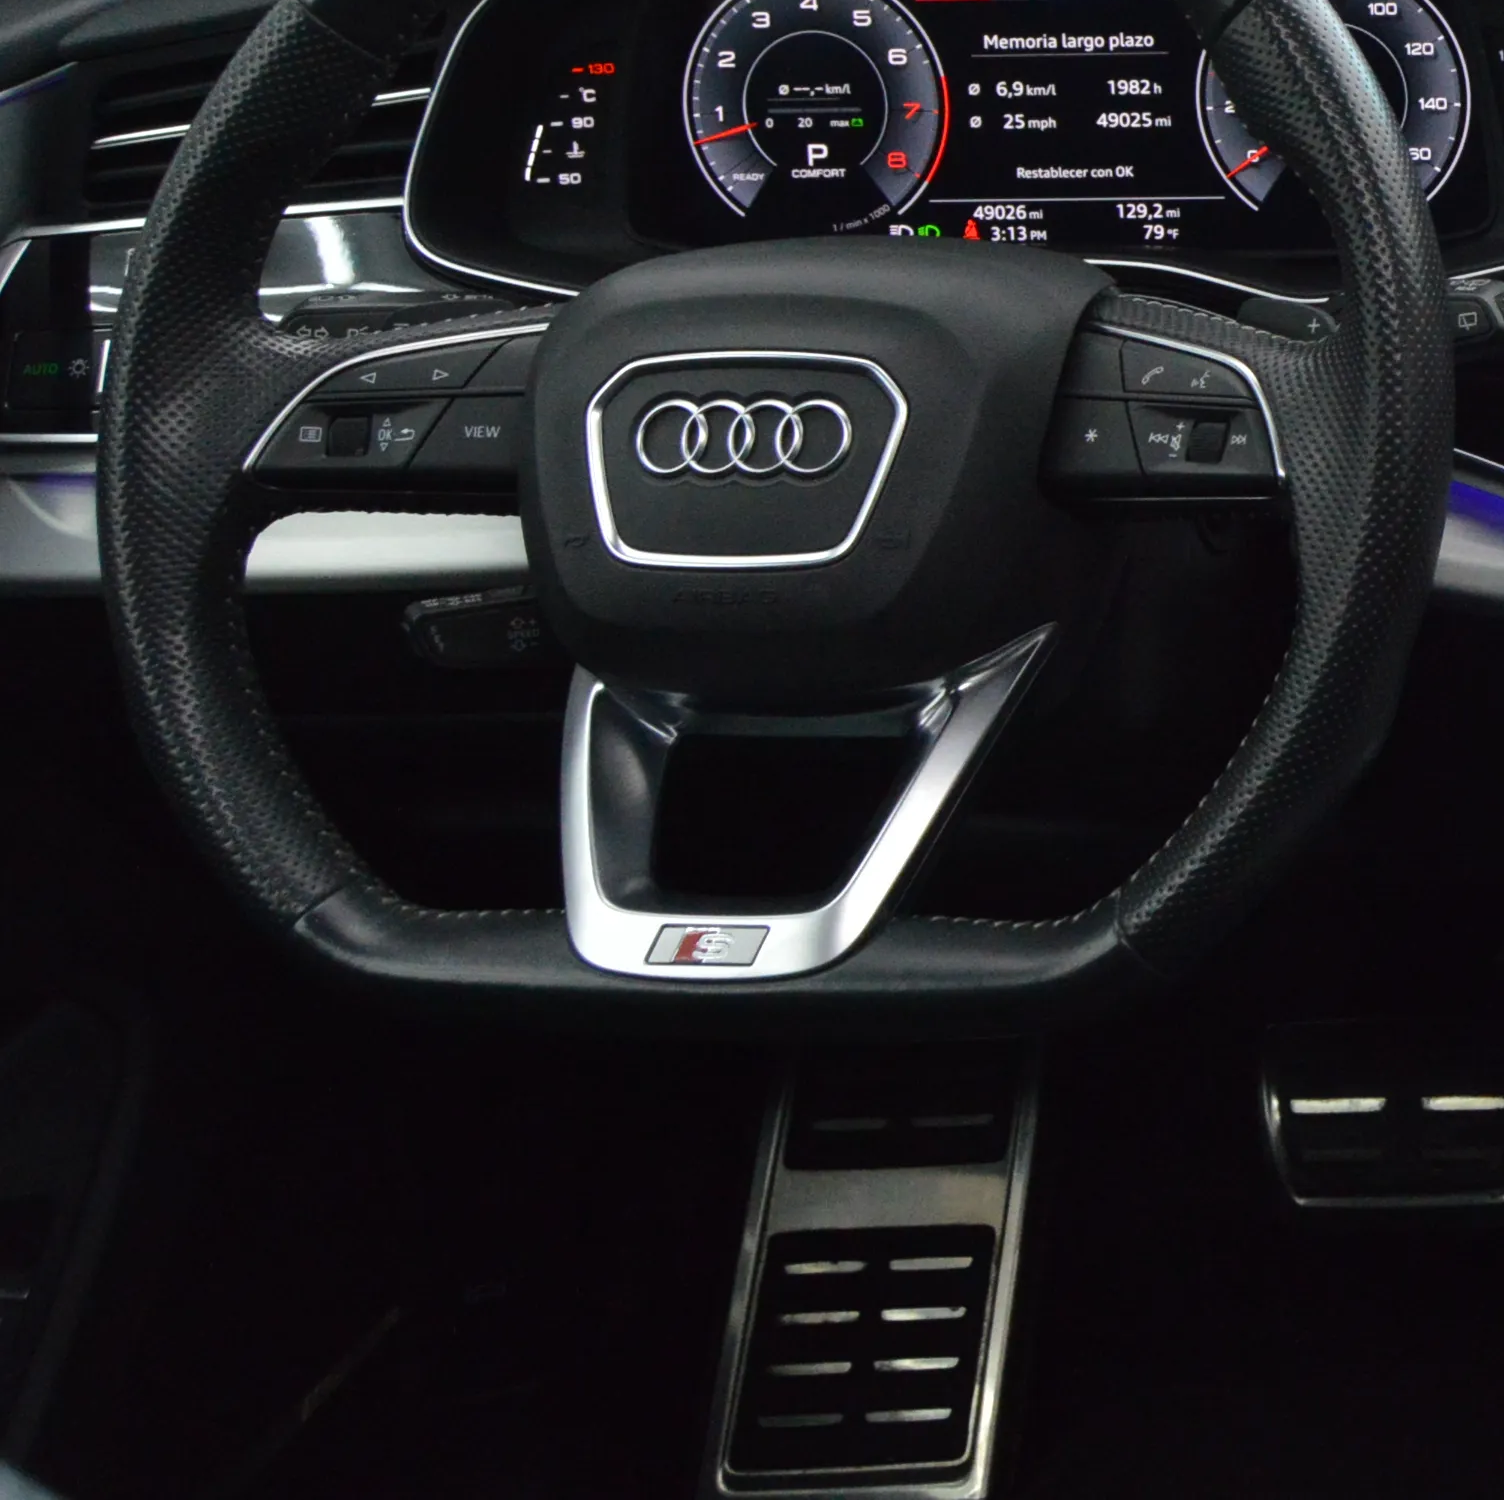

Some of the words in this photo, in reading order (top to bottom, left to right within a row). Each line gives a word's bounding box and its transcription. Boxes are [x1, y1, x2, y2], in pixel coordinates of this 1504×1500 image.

[1368, 2, 1397, 15] 100
[752, 12, 770, 28] 3
[853, 10, 871, 26] 5
[984, 34, 1057, 49] Memoria
[1062, 33, 1105, 52] largo
[1109, 32, 1154, 51] plazo
[1405, 42, 1434, 55] 120
[717, 51, 735, 68] 2
[888, 48, 907, 65] 6
[588, 63, 615, 74] 130
[996, 81, 1024, 98] 6,9
[1026, 84, 1056, 96] km/l
[1108, 79, 1150, 95] 1982
[1153, 83, 1162, 94] h
[904, 102, 921, 119] 7
[1419, 97, 1447, 110] 140
[715, 106, 723, 121] 1
[1096, 112, 1152, 128] 49025
[1155, 116, 1171, 126] mi
[571, 117, 594, 128] 90
[765, 118, 774, 128] 0
[798, 117, 813, 128] 20
[1004, 114, 1025, 129] 25
[1028, 117, 1056, 131] mph
[807, 144, 828, 166] P
[888, 152, 907, 168] 8
[558, 173, 581, 185] 50
[732, 173, 765, 182] READY
[792, 169, 846, 178] COMFORT
[1016, 167, 1088, 179] Restablecer
[1091, 169, 1113, 178] con
[1115, 166, 1134, 177] OK
[972, 205, 1026, 221] 49026
[1029, 210, 1043, 219] mi
[1116, 203, 1163, 220] 129,2
[1166, 208, 1180, 218] mi
[991, 226, 1027, 241] 3:13
[1030, 230, 1047, 240] PM
[1143, 225, 1164, 239] 79
[23, 363, 58, 375] AUTO
[377, 428, 393, 442] OK
[465, 426, 500, 438] VIEW
